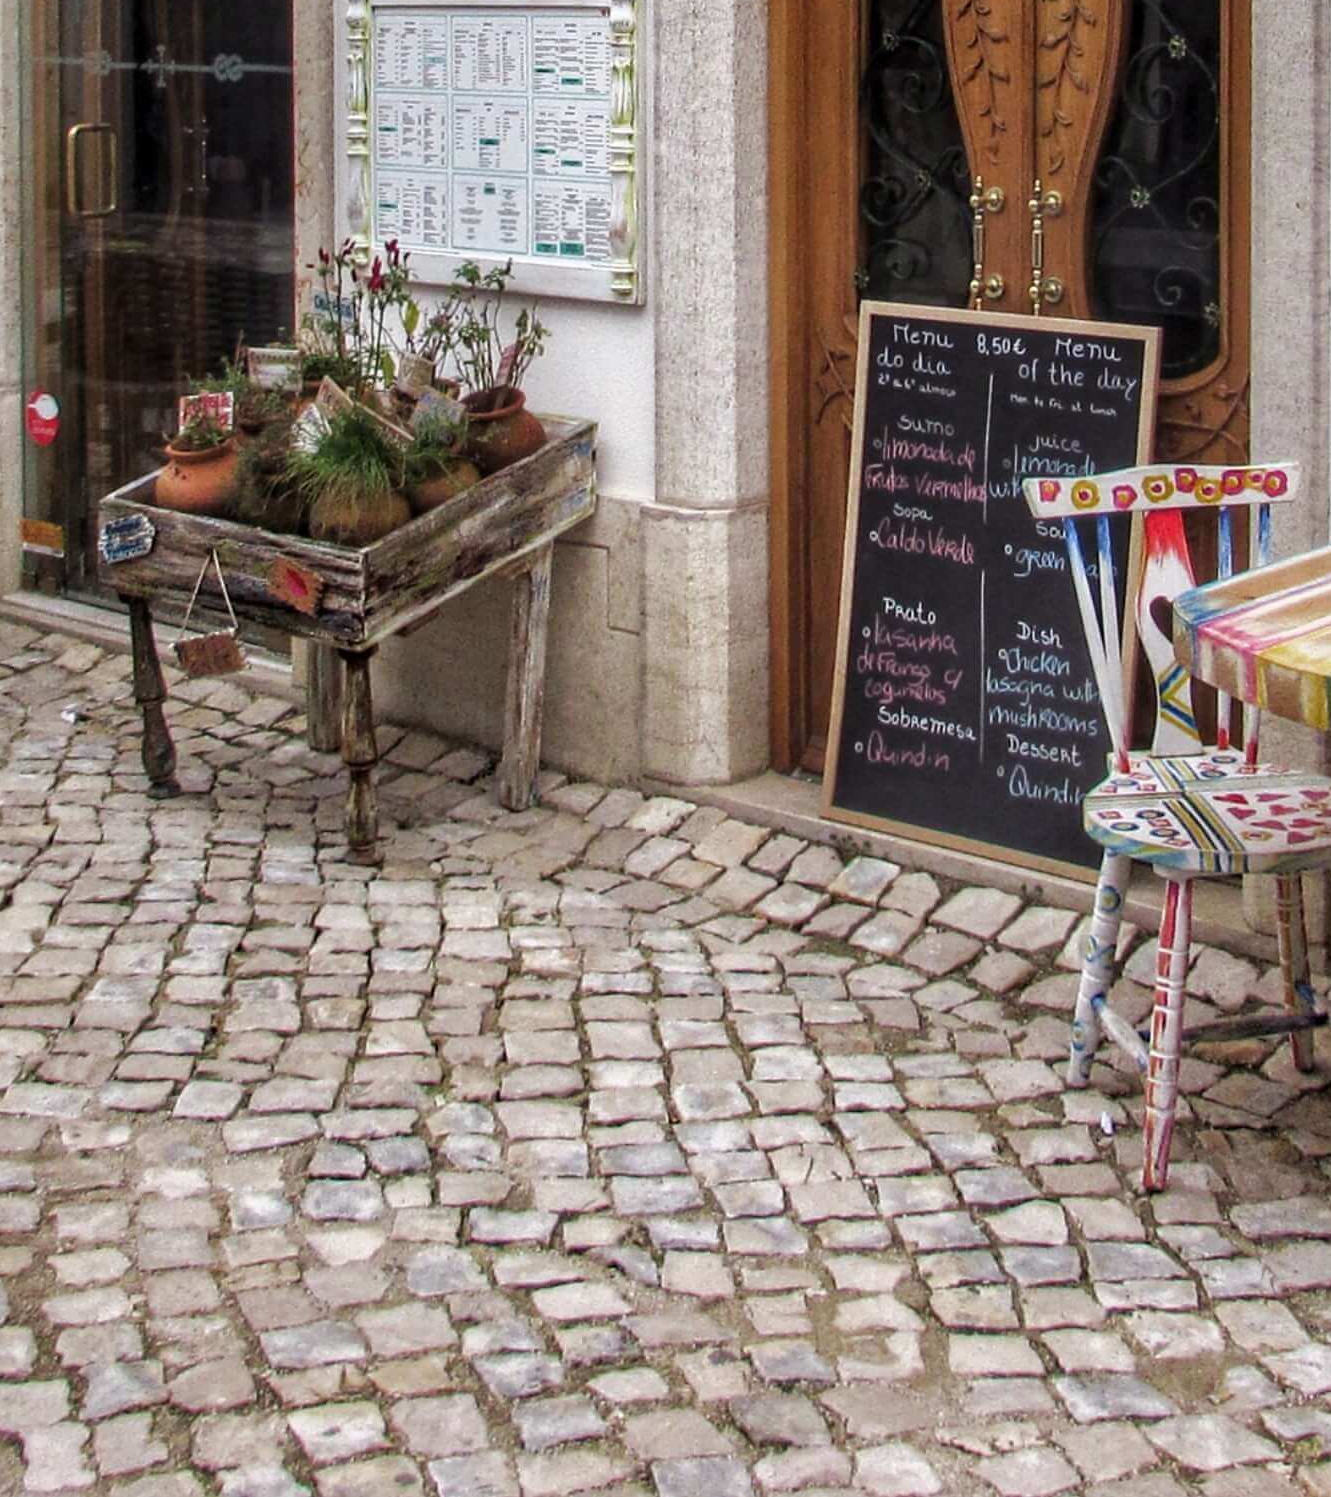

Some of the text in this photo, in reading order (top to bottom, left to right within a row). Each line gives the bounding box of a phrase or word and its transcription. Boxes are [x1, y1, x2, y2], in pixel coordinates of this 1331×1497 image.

[892, 323, 955, 349] Menu
[1054, 338, 1123, 363] Menu
[876, 346, 952, 376] do dia
[1018, 357, 1138, 401] of the day
[1016, 620, 1063, 649] Dish
